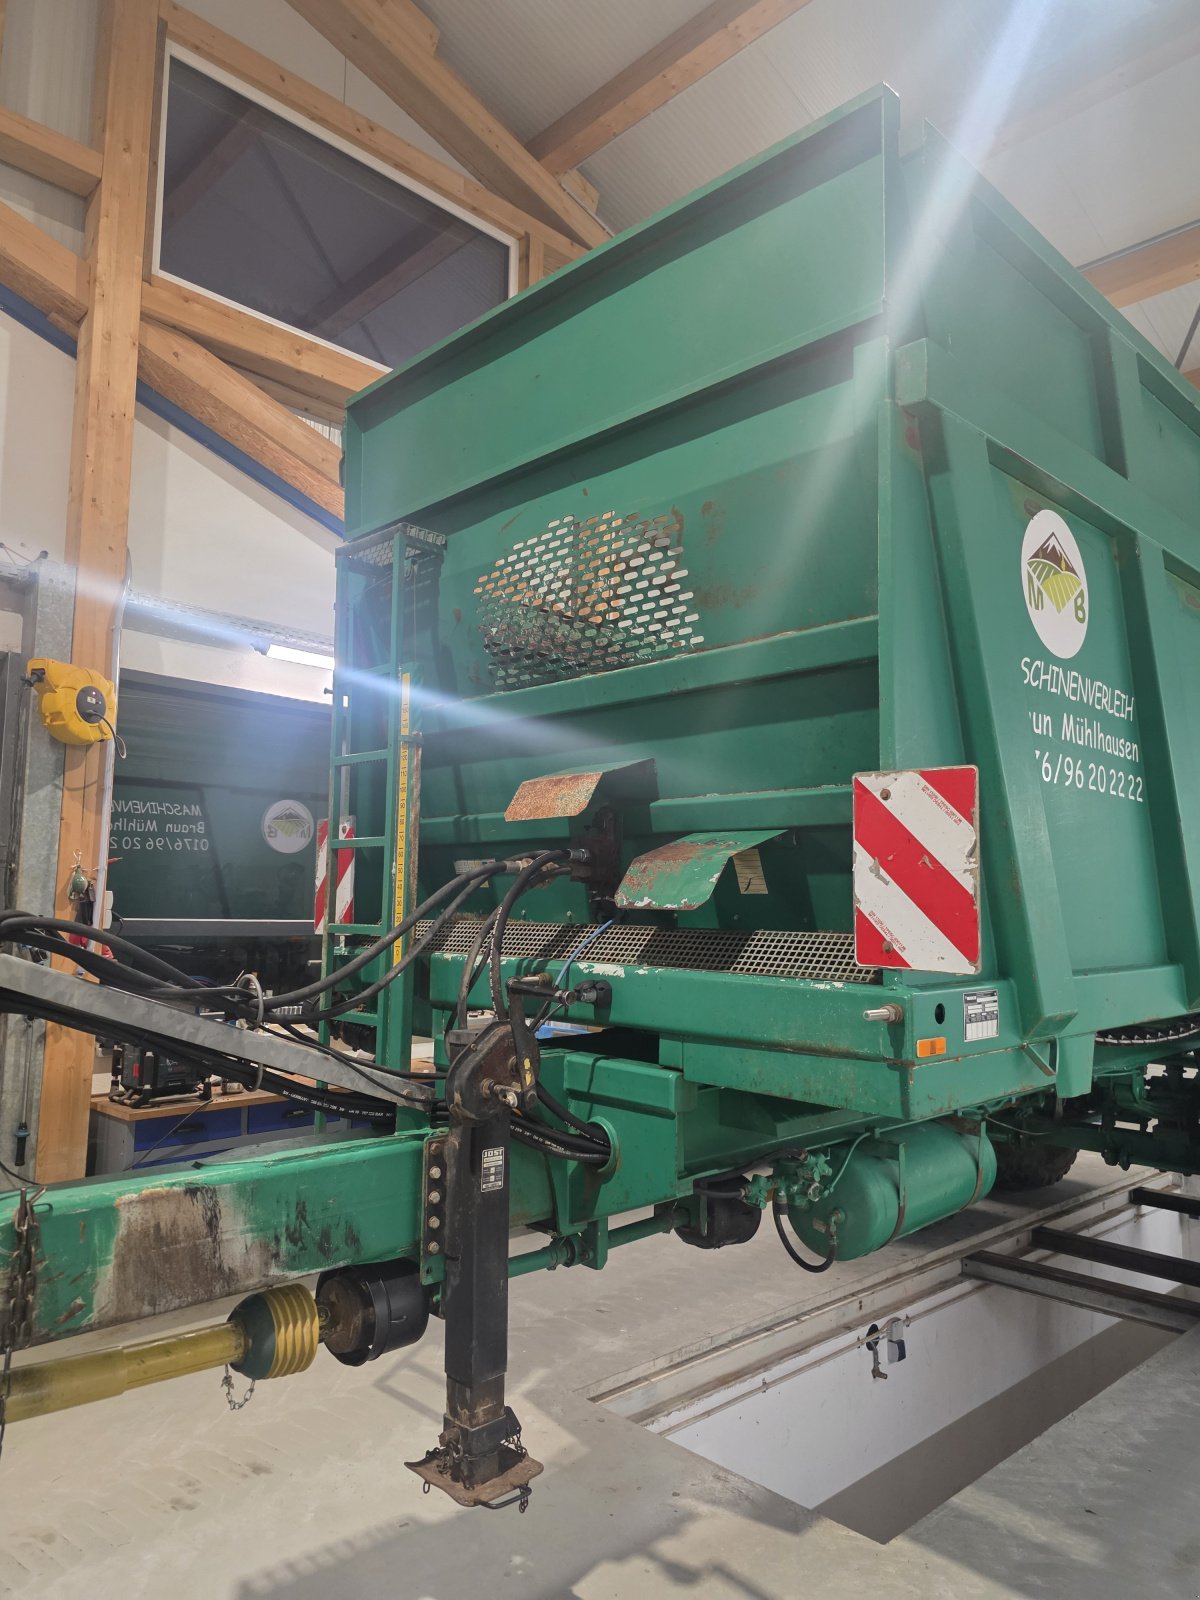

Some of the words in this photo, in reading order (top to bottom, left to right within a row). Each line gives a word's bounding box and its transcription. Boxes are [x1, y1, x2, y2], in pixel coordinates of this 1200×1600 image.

[1021, 657, 1134, 721] SCHINENVERLEIH
[1029, 712, 1052, 737] un
[1062, 713, 1139, 763] Mühlhausen
[1088, 763, 1107, 792] 20
[1109, 769, 1125, 797] 22
[1128, 775, 1143, 802] 22
[483, 1149, 503, 1157] JOST
